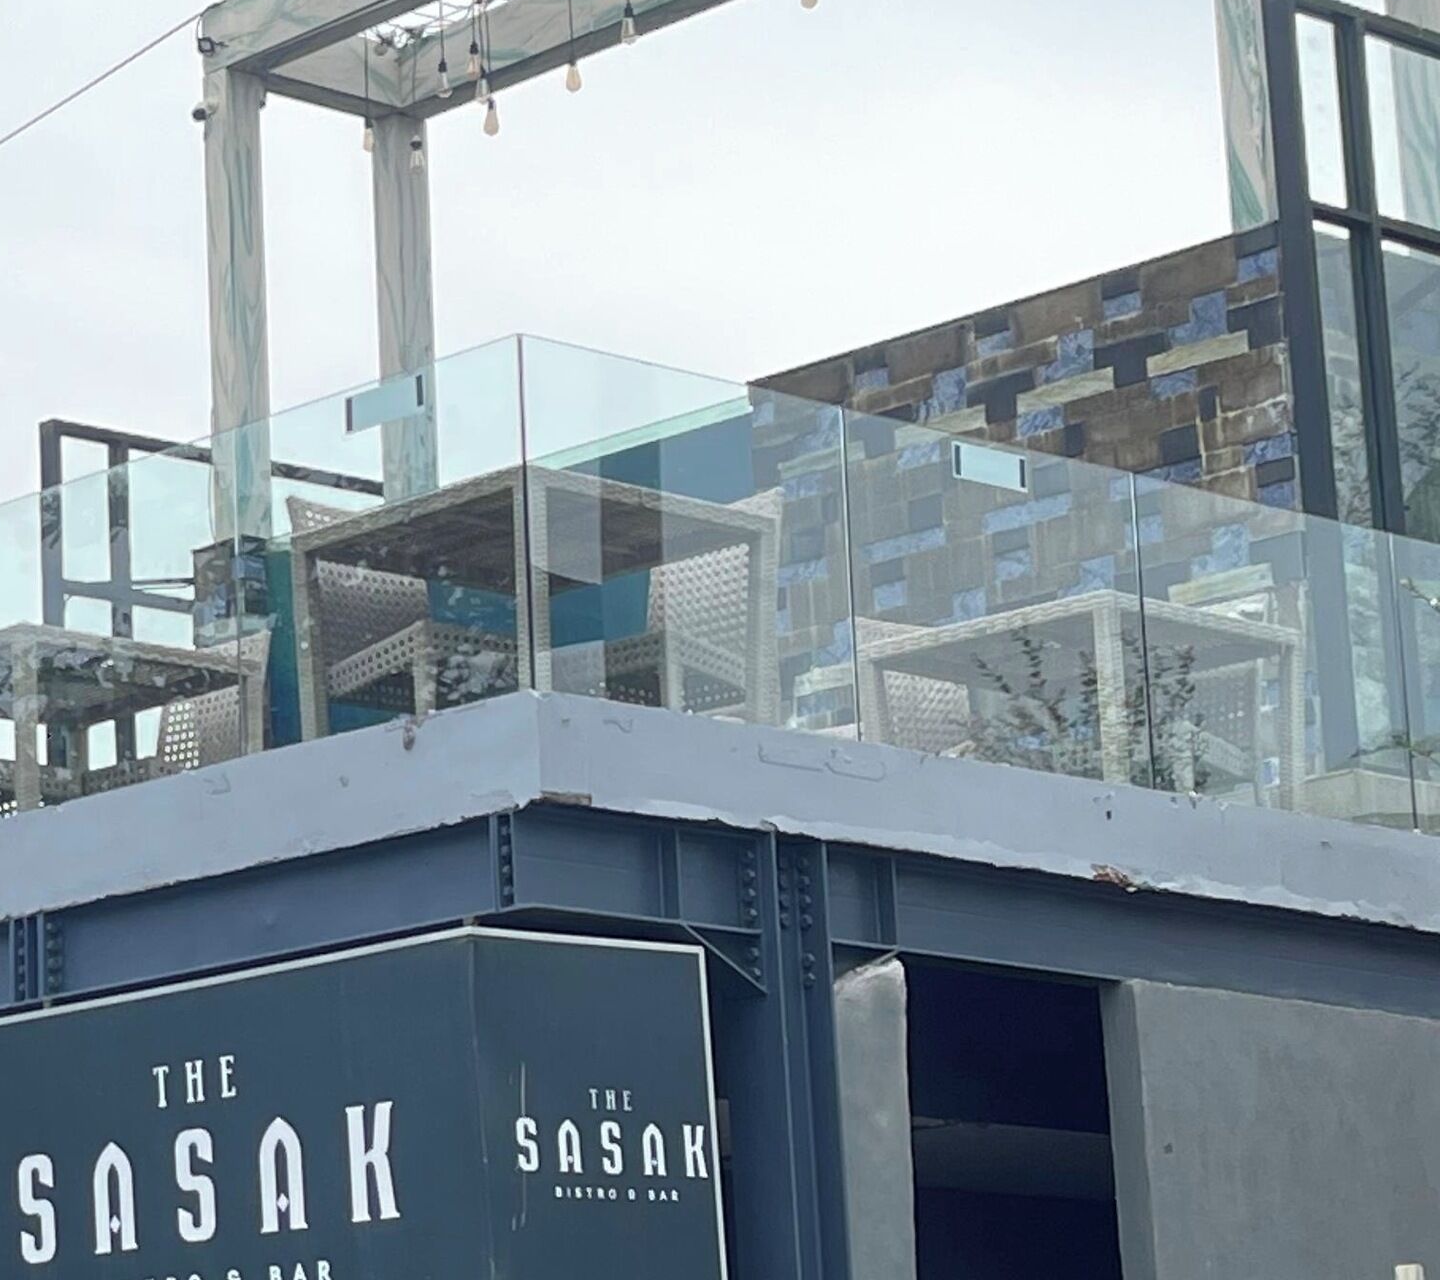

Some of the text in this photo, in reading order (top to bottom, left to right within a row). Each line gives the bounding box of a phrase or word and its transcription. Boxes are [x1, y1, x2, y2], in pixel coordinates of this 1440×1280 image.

[152, 1054, 237, 1108] THE
[589, 1088, 632, 1111] THE
[515, 1116, 709, 1178] SASAK
[18, 1100, 401, 1264] SASAK
[554, 1186, 617, 1200] BISTRO
[648, 1189, 680, 1202] BAR
